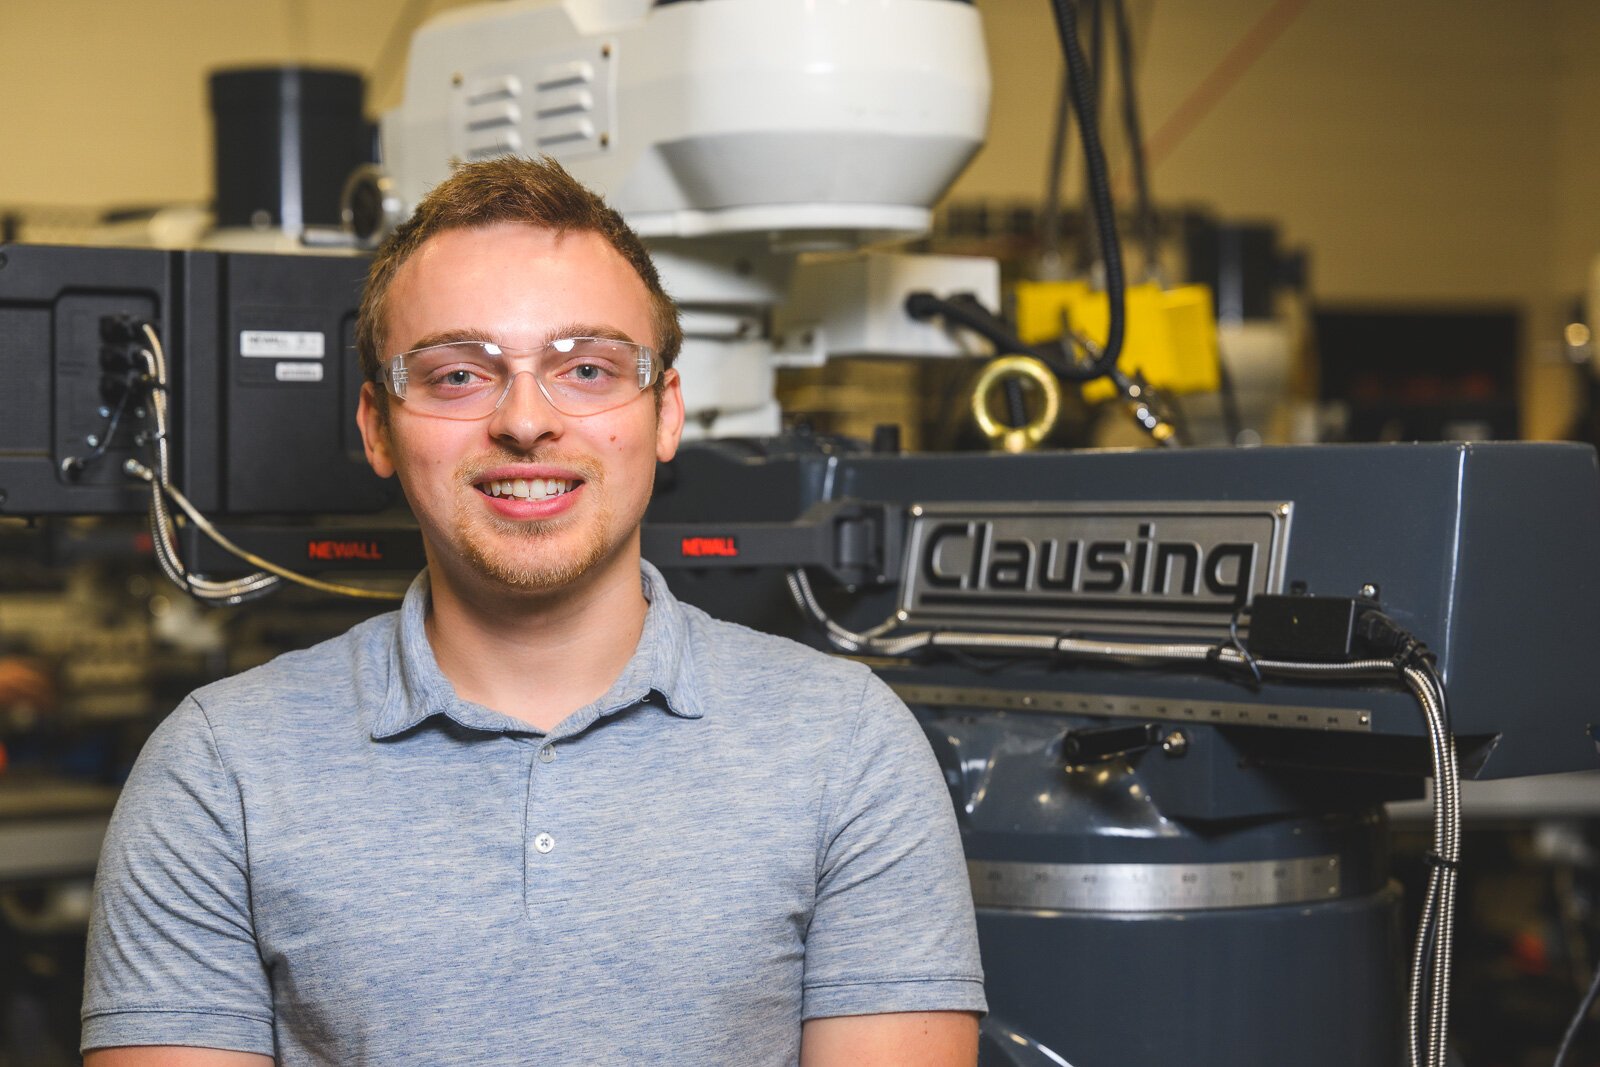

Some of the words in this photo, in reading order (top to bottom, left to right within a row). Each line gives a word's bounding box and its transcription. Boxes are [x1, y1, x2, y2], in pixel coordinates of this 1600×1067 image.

[309, 541, 383, 559] NEWALL
[682, 537, 737, 556] NEWALL
[922, 521, 1258, 610] Clausing
